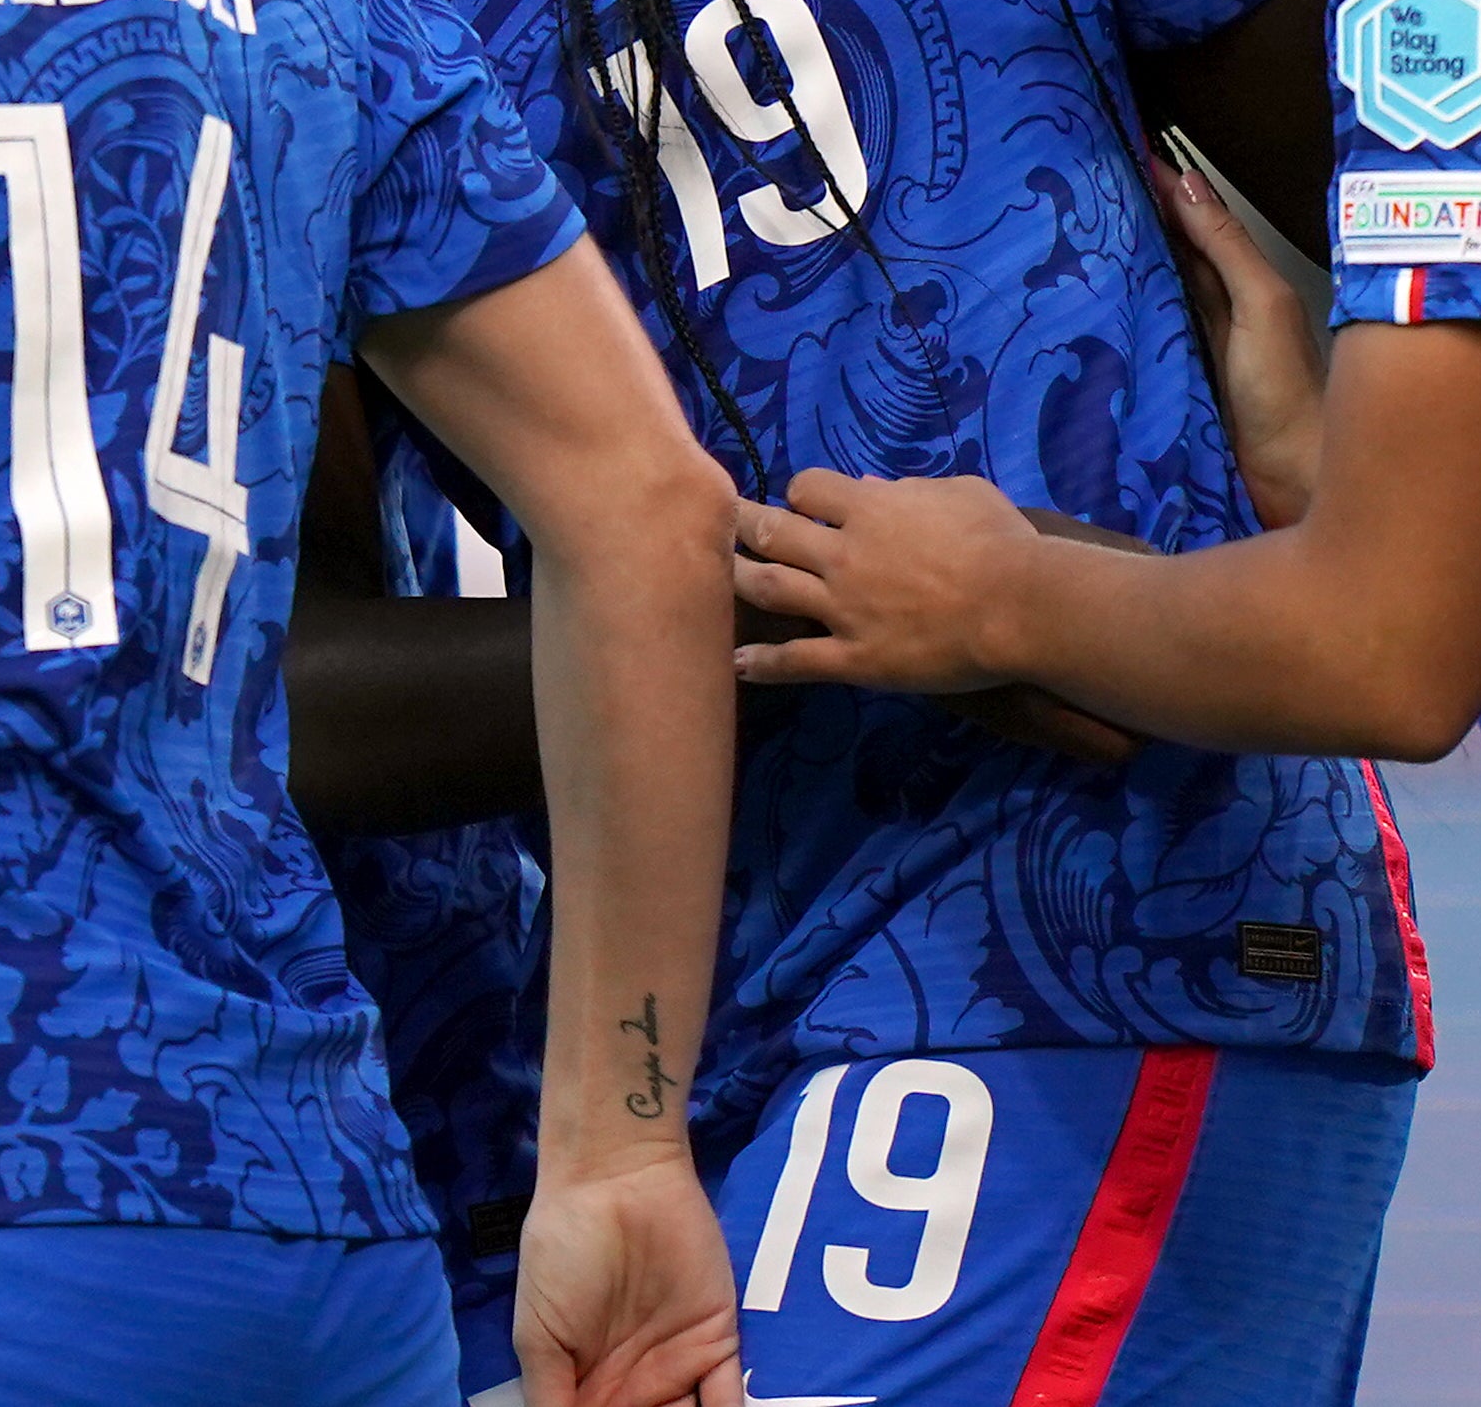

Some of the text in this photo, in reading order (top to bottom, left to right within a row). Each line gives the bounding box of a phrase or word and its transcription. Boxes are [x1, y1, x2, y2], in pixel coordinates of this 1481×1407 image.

[1390, 6, 1422, 26] We
[1391, 29, 1437, 57] Play
[1391, 55, 1464, 80] Strong
[741, 1058, 994, 1322] 19
